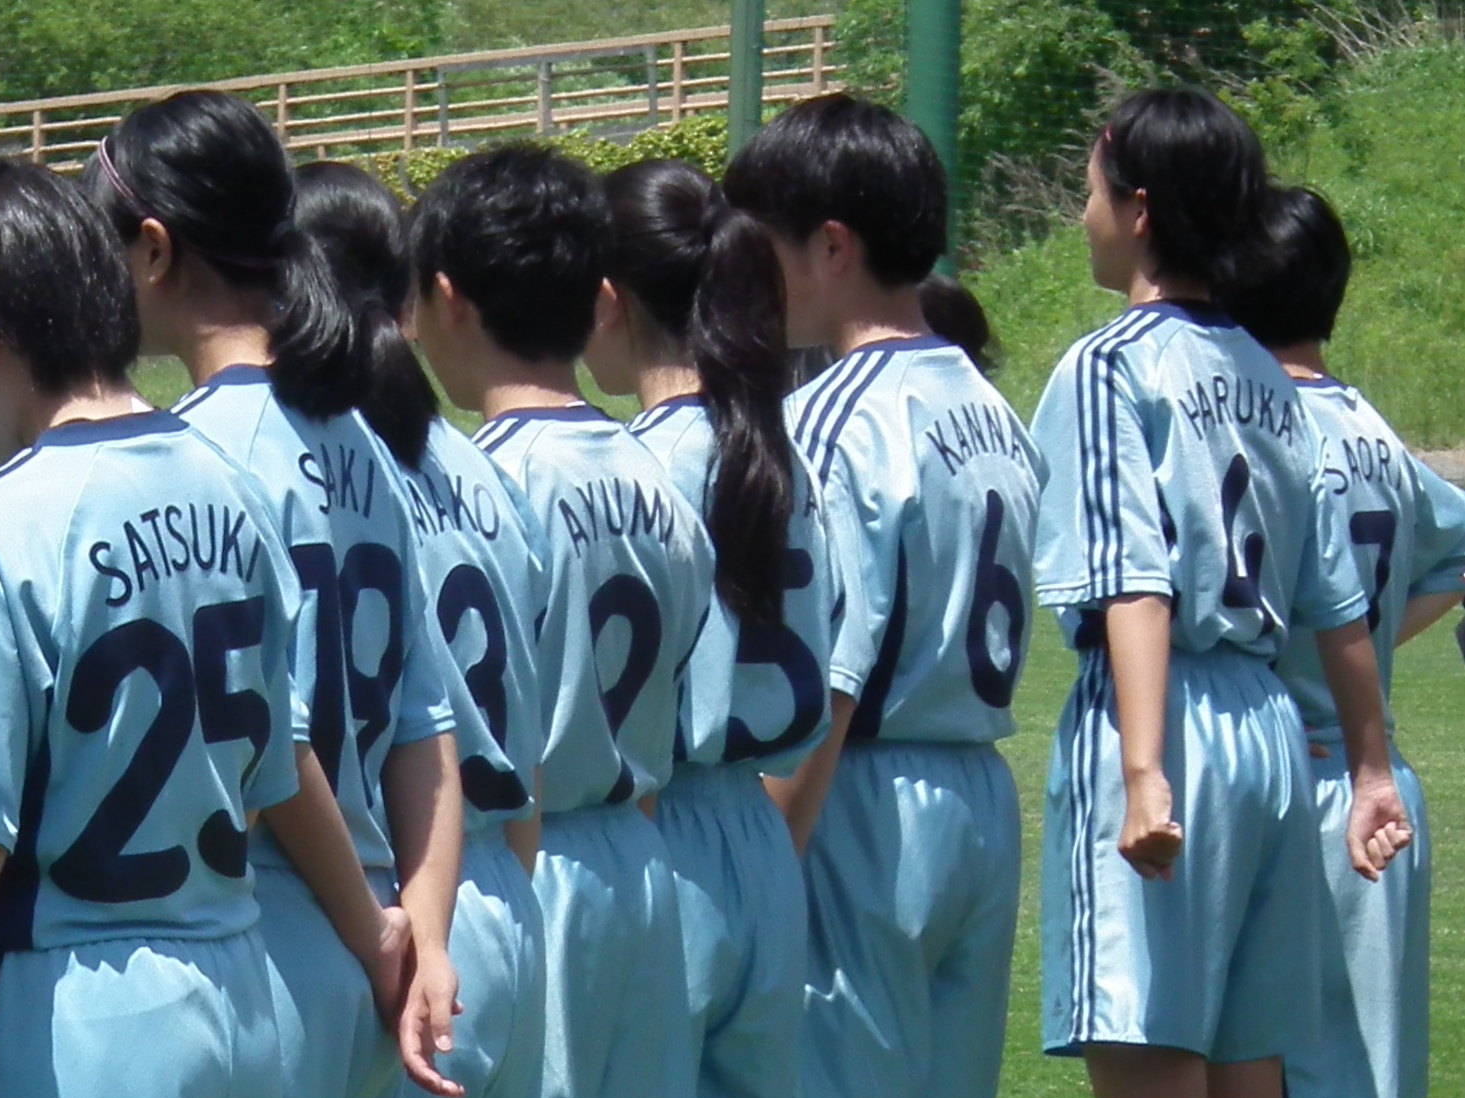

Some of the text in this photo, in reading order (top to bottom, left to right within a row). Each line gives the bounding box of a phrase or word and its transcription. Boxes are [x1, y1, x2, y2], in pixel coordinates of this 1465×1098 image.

[89, 503, 261, 607] SATSUKI
[298, 443, 374, 519] SAKI
[966, 489, 1025, 709] 6
[1349, 510, 1397, 634] 7
[49, 593, 272, 903] 25
[437, 563, 531, 812] 3
